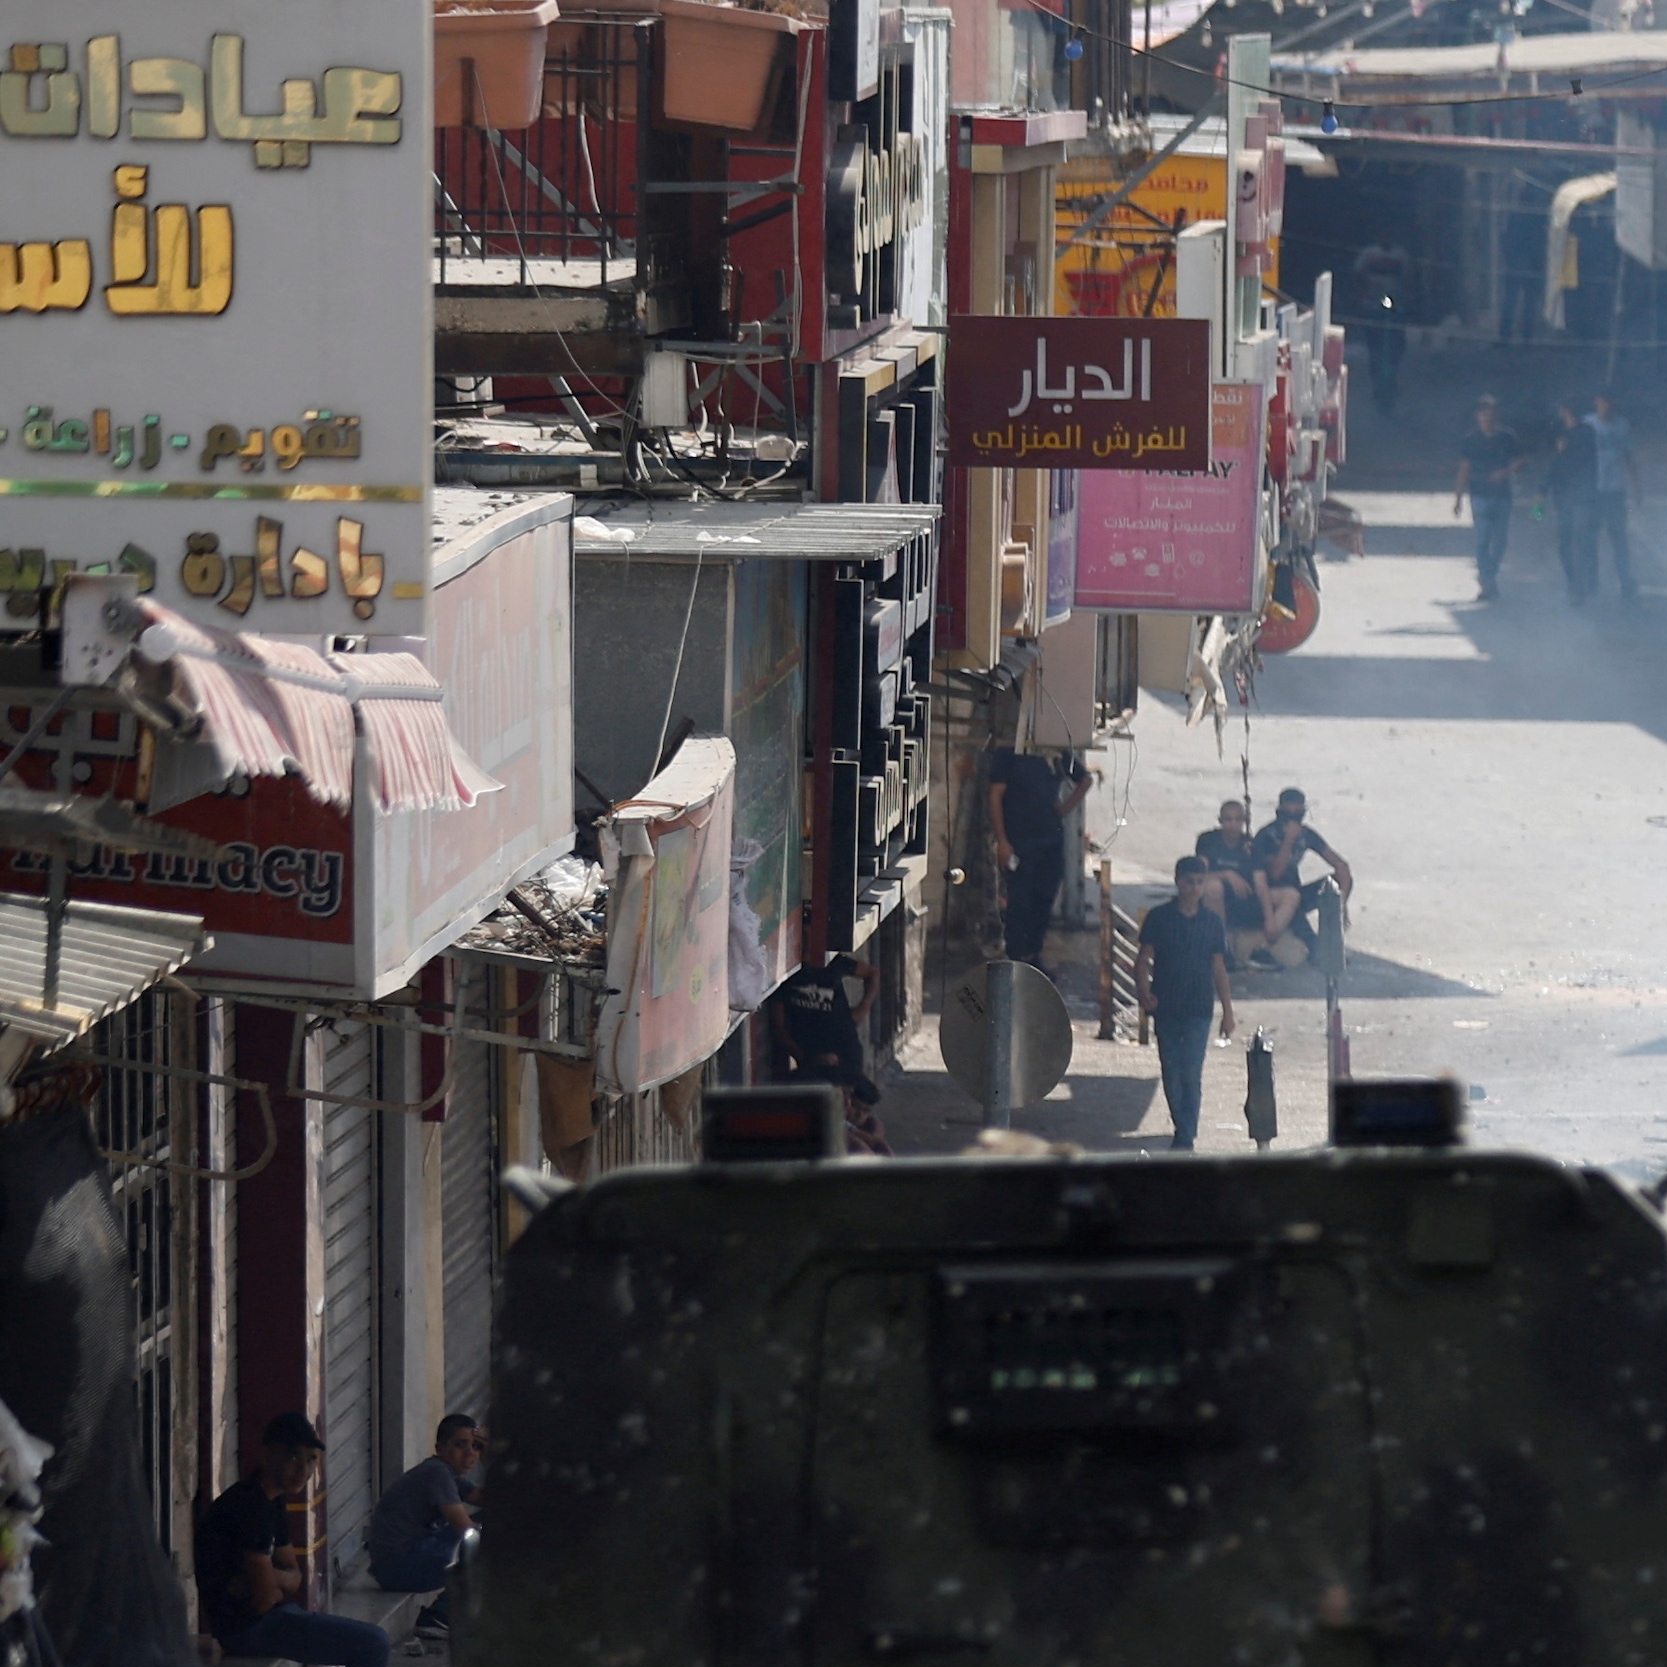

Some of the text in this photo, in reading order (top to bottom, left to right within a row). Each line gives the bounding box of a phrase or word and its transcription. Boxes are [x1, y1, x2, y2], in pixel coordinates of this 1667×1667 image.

[0, 34, 402, 168] عيادات
[1008, 336, 1151, 417] الديار
[23, 405, 161, 470] زراعة
[200, 410, 361, 472] تقويم
[973, 421, 1186, 458] للفرش المنزلي
